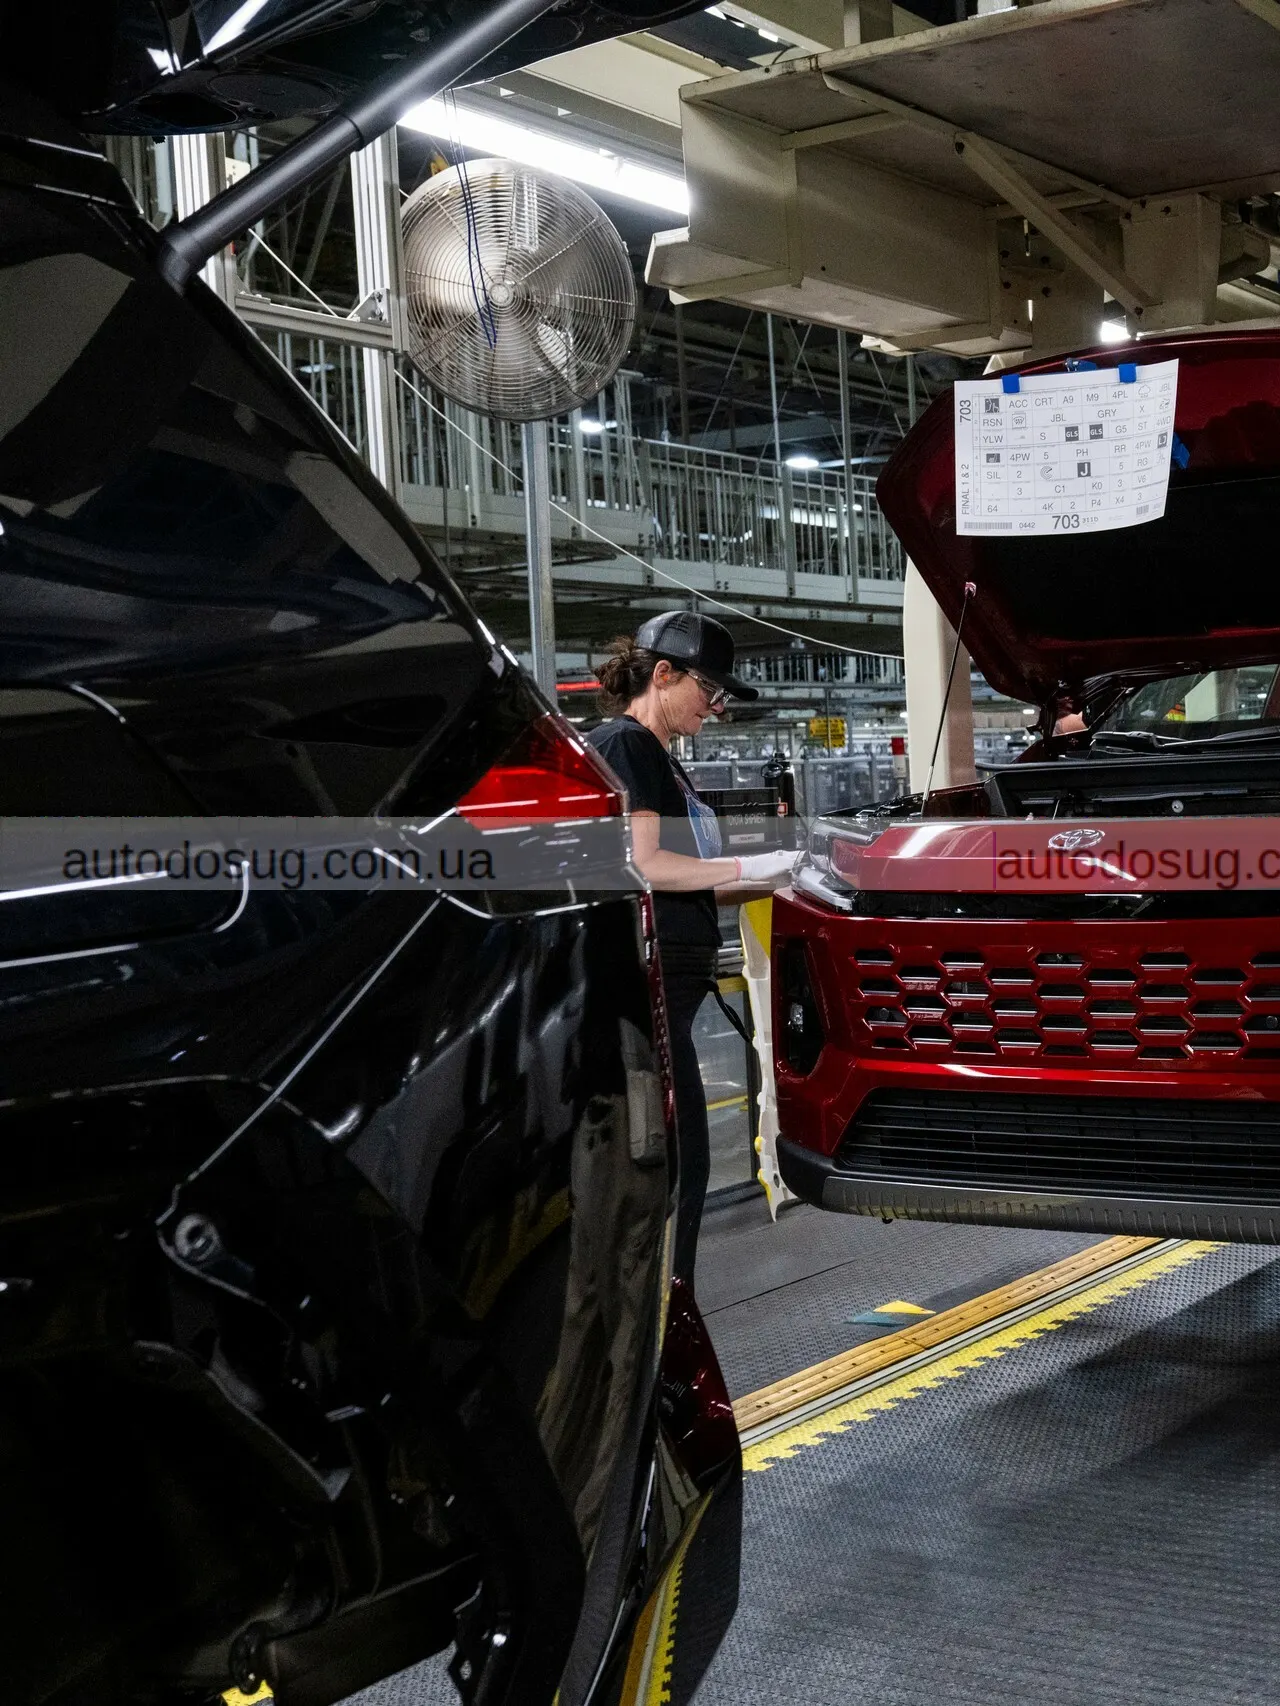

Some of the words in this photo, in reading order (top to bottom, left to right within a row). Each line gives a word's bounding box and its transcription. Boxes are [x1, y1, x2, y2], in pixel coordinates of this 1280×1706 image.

[1009, 400, 1027, 408] ACC
[1035, 398, 1053, 406] CRT
[1063, 396, 1074, 404] A9
[1087, 393, 1099, 402] M9
[1112, 390, 1128, 399] 4PL
[1159, 383, 1171, 393] JBL
[960, 400, 971, 422] 703
[983, 419, 1003, 427] RSN
[1051, 413, 1066, 422] JBL
[1097, 409, 1117, 418] GRY
[1040, 432, 1046, 440] S
[1066, 430, 1078, 438] GLS
[1090, 427, 1102, 436] GLS
[1116, 425, 1127, 434] G5
[1138, 421, 1148, 430] ST
[1156, 416, 1171, 426] 4WD
[1010, 453, 1030, 461] 4PW
[1044, 452, 1049, 460] 5
[1076, 448, 1089, 457] PH
[1114, 445, 1126, 454] RR
[1135, 441, 1152, 450] 4PW
[1016, 470, 1022, 478] 2
[1080, 463, 1088, 476] J
[1119, 462, 1124, 470] 5
[1017, 488, 1022, 496] 3
[1054, 485, 1066, 494] C1
[1118, 479, 1123, 488] 3
[961, 489, 970, 515] FINAL
[987, 504, 998, 512] 64
[1070, 501, 1076, 510] 2
[1092, 500, 1101, 508] P4
[1116, 496, 1125, 504] X4
[1138, 492, 1142, 501] 3
[1052, 514, 1080, 530] 703
